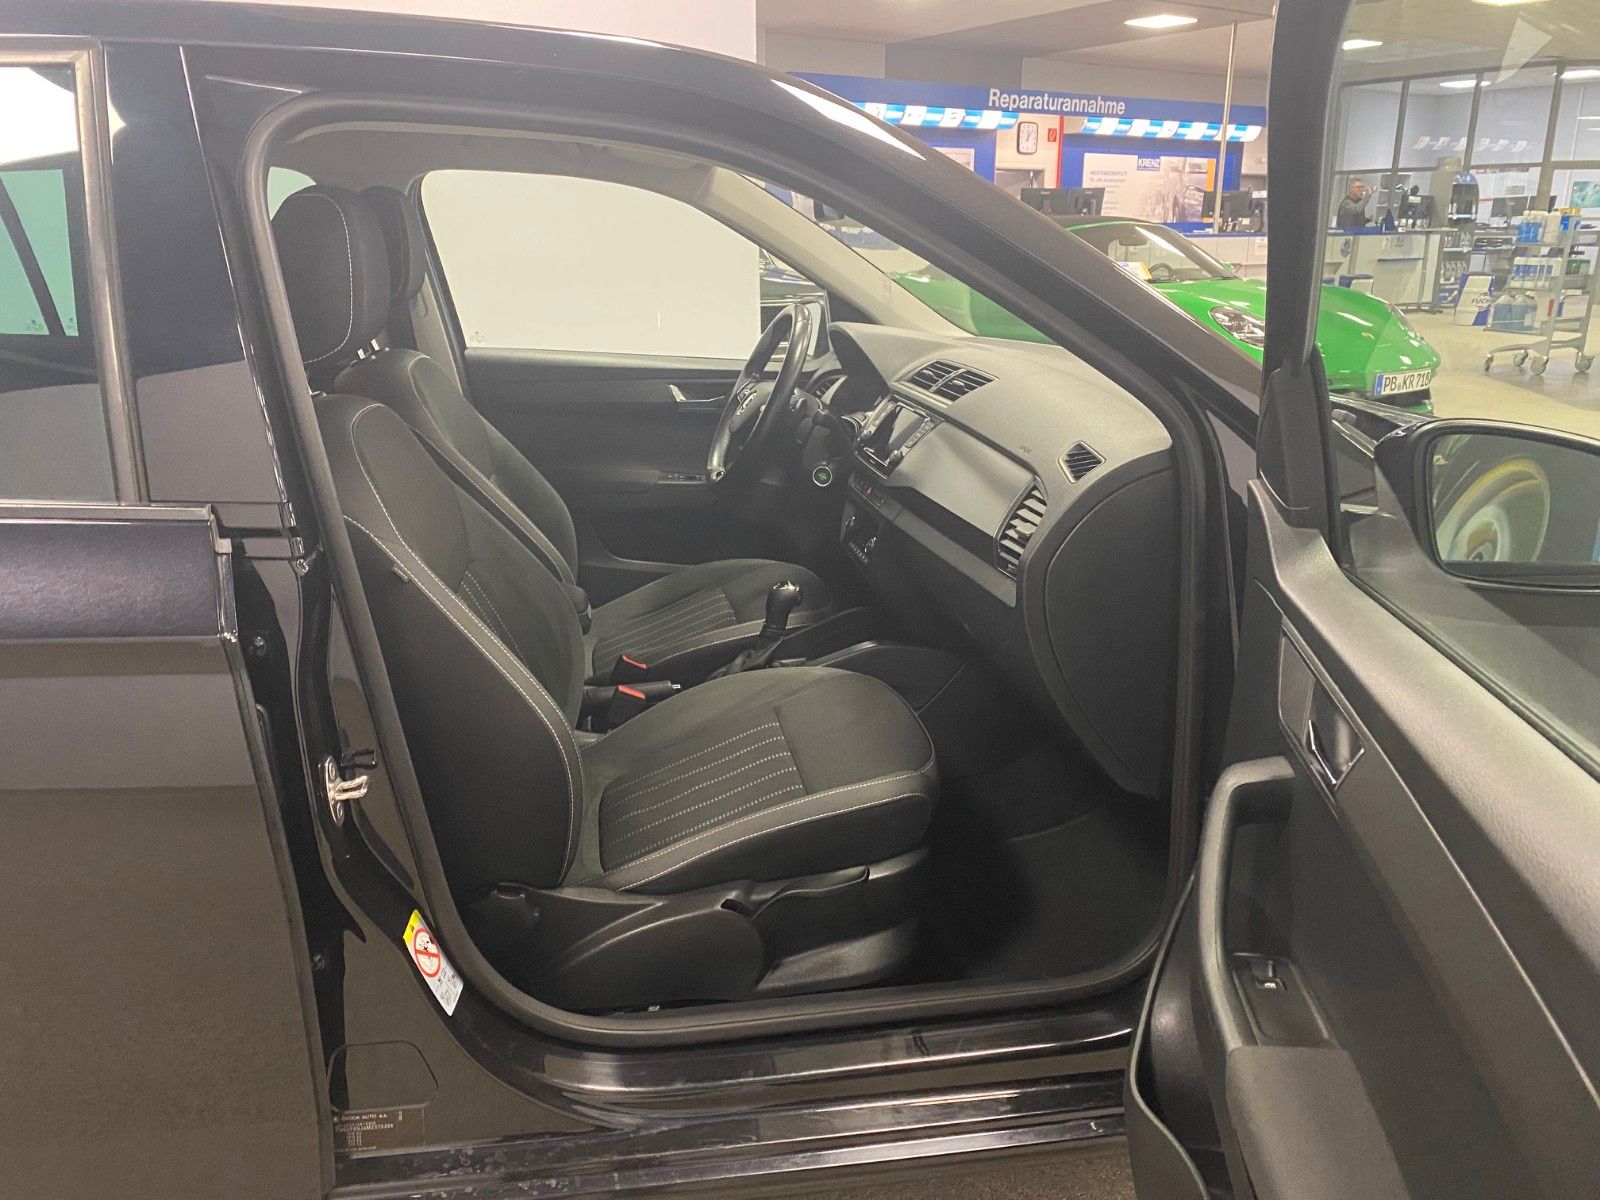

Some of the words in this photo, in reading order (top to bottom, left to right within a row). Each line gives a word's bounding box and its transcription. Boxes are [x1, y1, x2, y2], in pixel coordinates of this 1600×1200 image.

[988, 88, 1126, 115] Reparaturannahme
[1138, 158, 1160, 168] KRENZ
[1383, 376, 1397, 391] PB
[1402, 374, 1415, 390] KR
